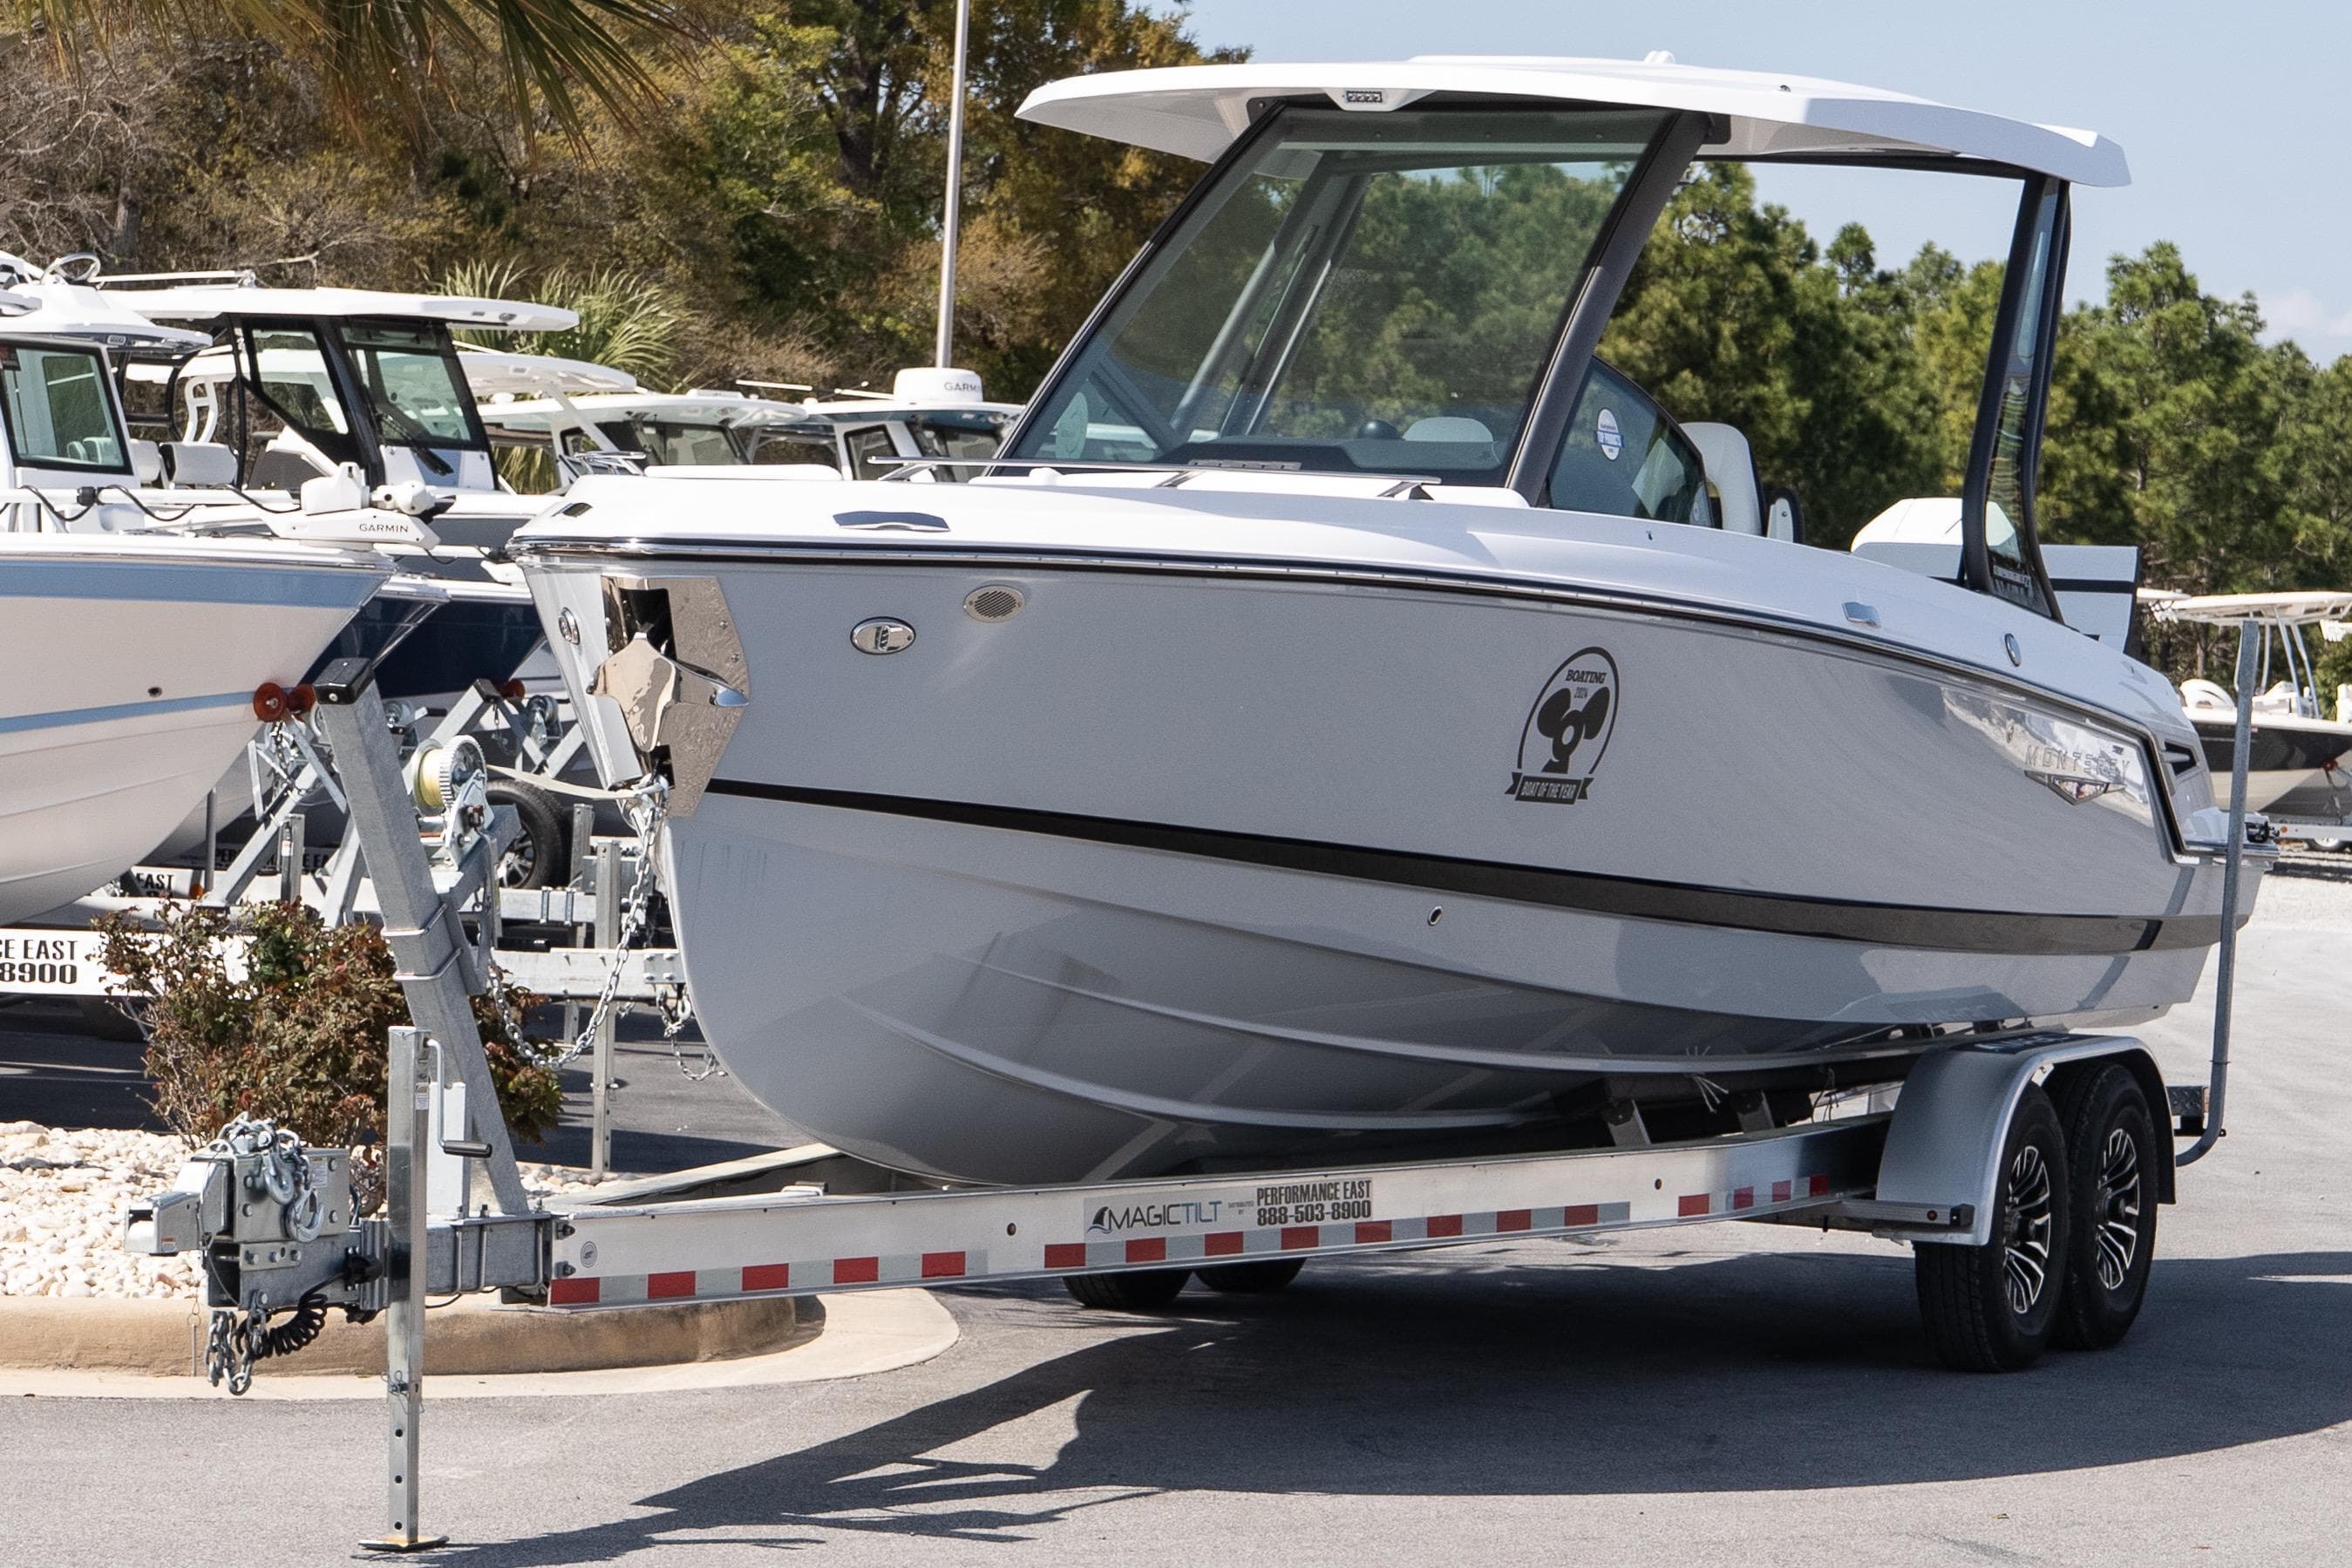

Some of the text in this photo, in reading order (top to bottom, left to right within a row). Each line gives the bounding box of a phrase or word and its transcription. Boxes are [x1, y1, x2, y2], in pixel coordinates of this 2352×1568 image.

[359, 523, 409, 533] GARMIN
[1565, 669, 1607, 684] BOATING
[2025, 744, 2131, 783] MONTEREY
[1520, 780, 1540, 797] BOAT
[1546, 783, 1561, 798] THE
[1559, 784, 1577, 799] YEAR
[136, 872, 174, 891] EAST
[24, 939, 78, 960] EAST
[0, 961, 78, 985] 8900
[1256, 1180, 1372, 1207] PERFORMANCE EAST
[1108, 1199, 1223, 1230] MAGICTILT
[1256, 1199, 1372, 1226] 888-503-8900
